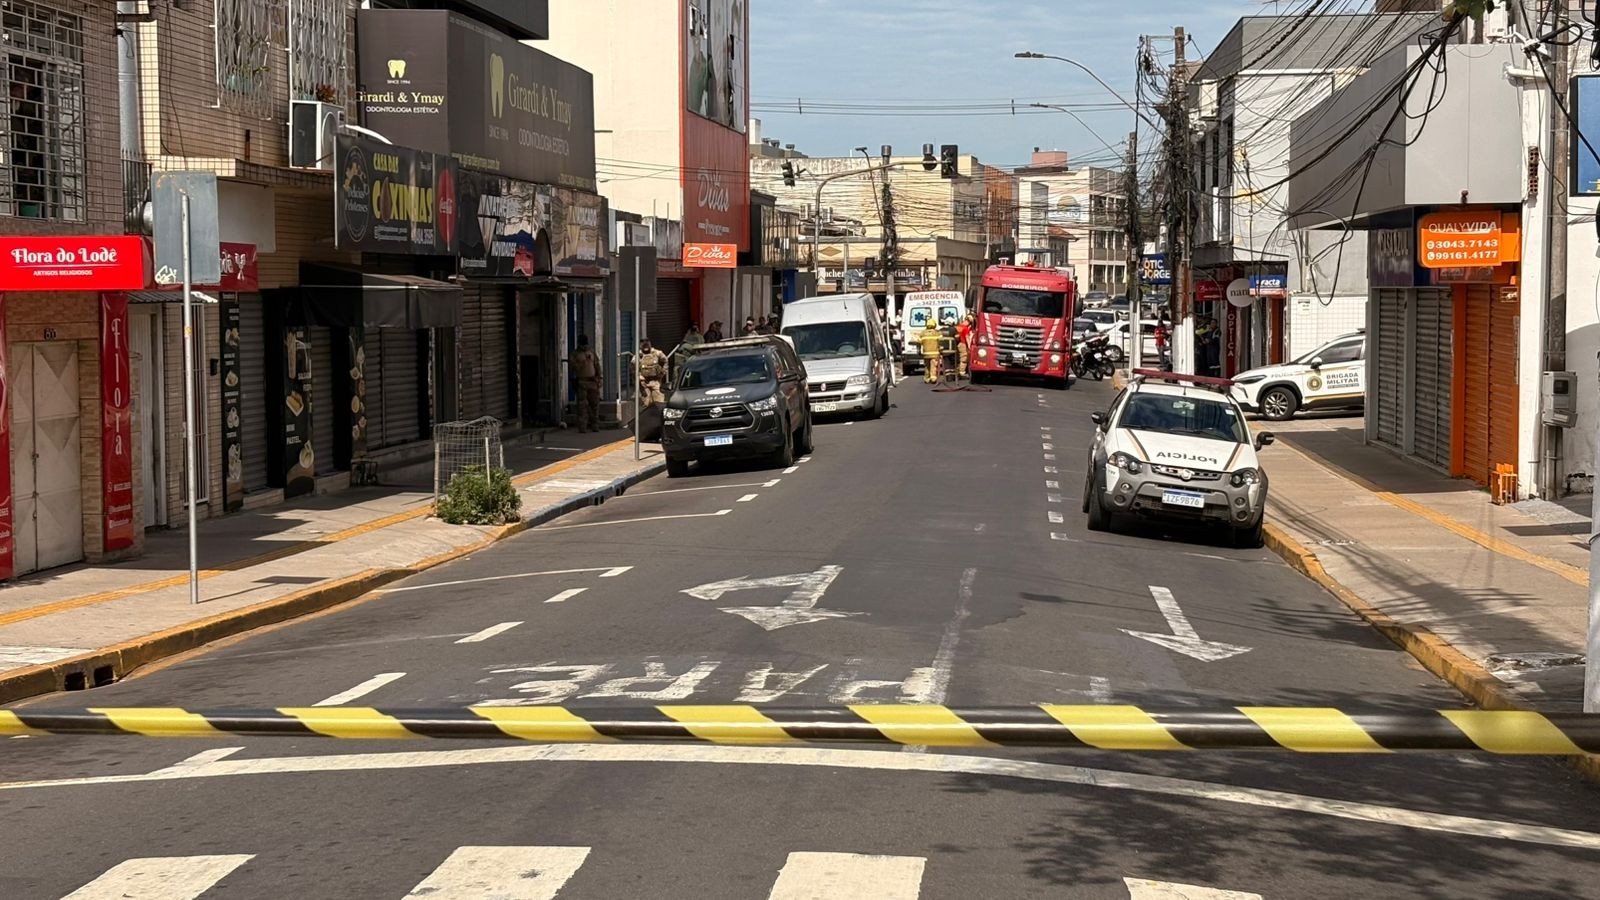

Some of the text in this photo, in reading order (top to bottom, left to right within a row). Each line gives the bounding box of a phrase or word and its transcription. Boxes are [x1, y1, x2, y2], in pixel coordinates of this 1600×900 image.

[397, 91, 408, 103] &
[411, 92, 445, 106] Ymay
[508, 73, 572, 131] Girardi & Ymay
[365, 105, 439, 114] ODONTOLOGIA ESTÉTICA
[373, 152, 387, 172] CASA
[388, 155, 399, 174] DAS
[697, 168, 730, 213] Divas
[1428, 221, 1497, 233] QUALYVIDA
[1435, 239, 1498, 249] 3043.7143
[11, 247, 117, 264] Flora do Lodê
[688, 247, 731, 259] Divas
[1435, 250, 1498, 260] 99161.4177
[1142, 269, 1171, 279] JORGE
